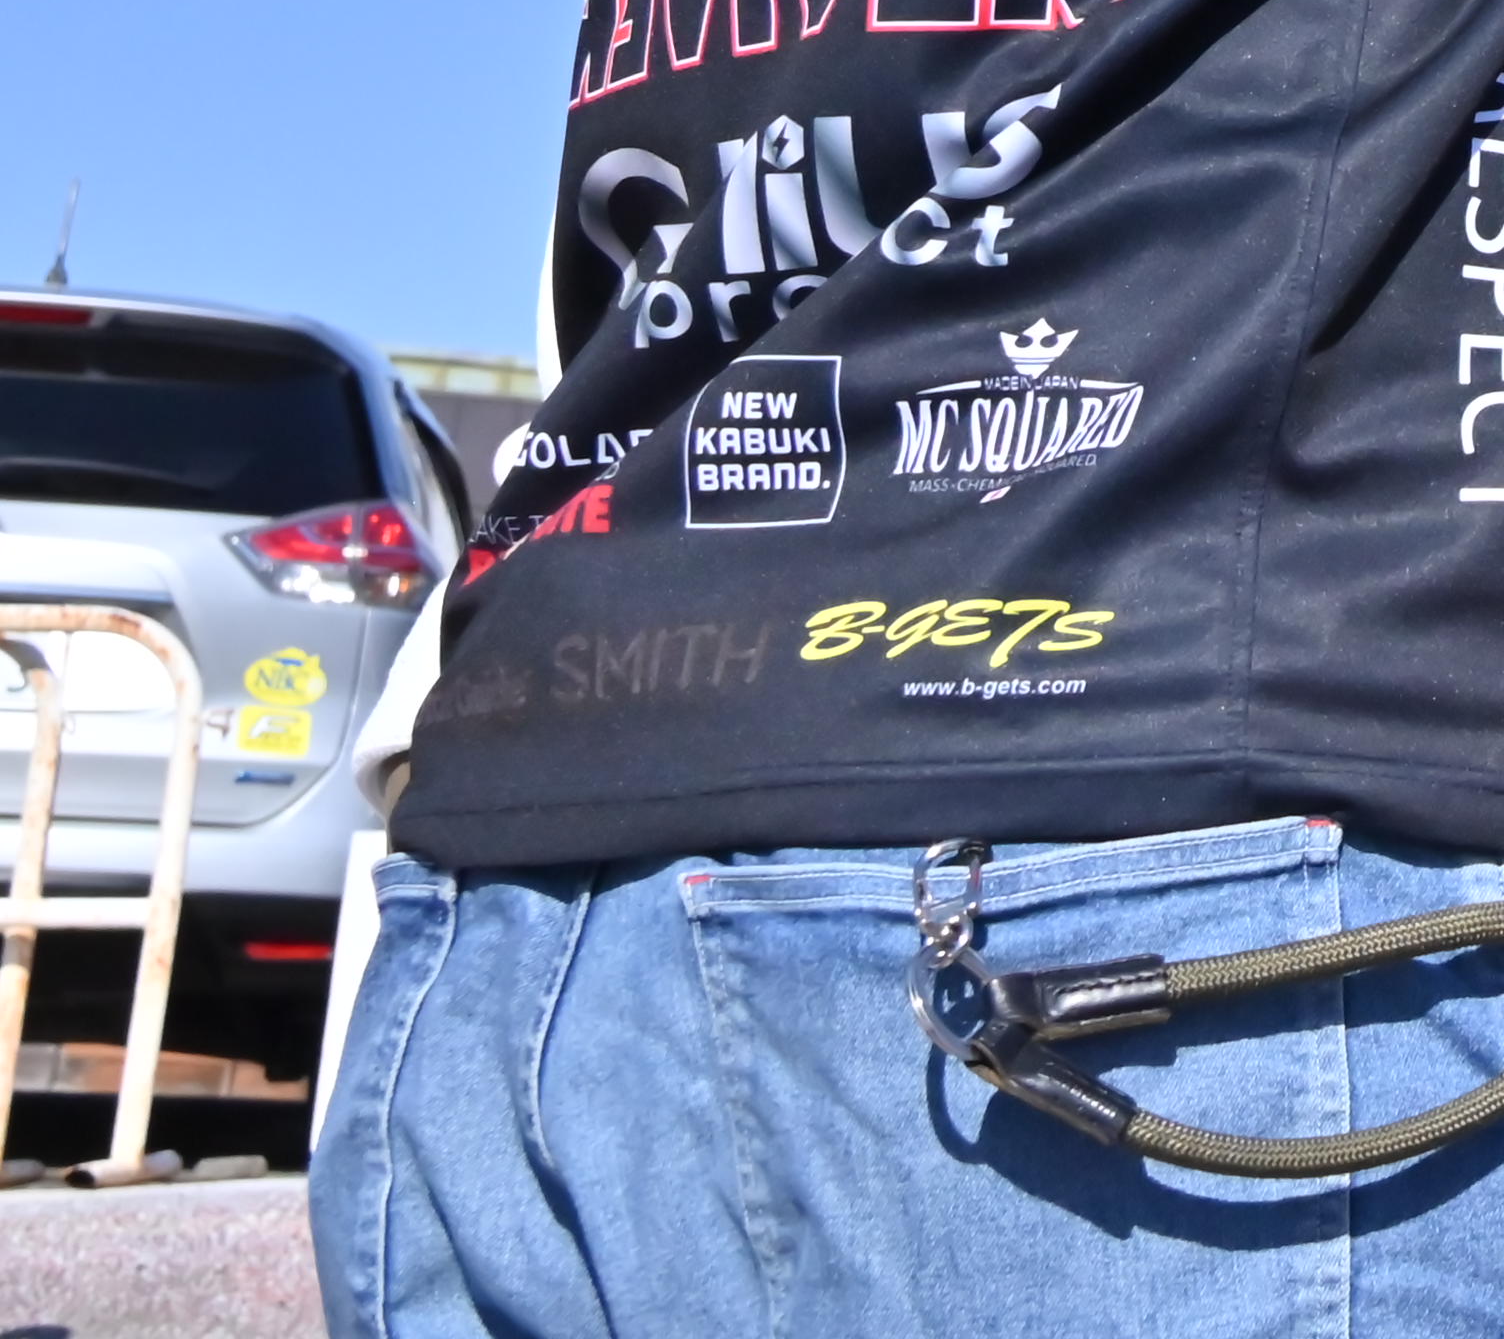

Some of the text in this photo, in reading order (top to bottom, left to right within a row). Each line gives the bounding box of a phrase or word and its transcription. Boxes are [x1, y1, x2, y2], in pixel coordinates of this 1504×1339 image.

[720, 391, 798, 420] NEW
[694, 426, 832, 455] KABUKI
[892, 385, 1144, 475] MC SQUARED
[696, 461, 832, 491] BRAND.
[552, 623, 773, 700] SMITH
[903, 678, 1087, 700] www.b-gets.com
